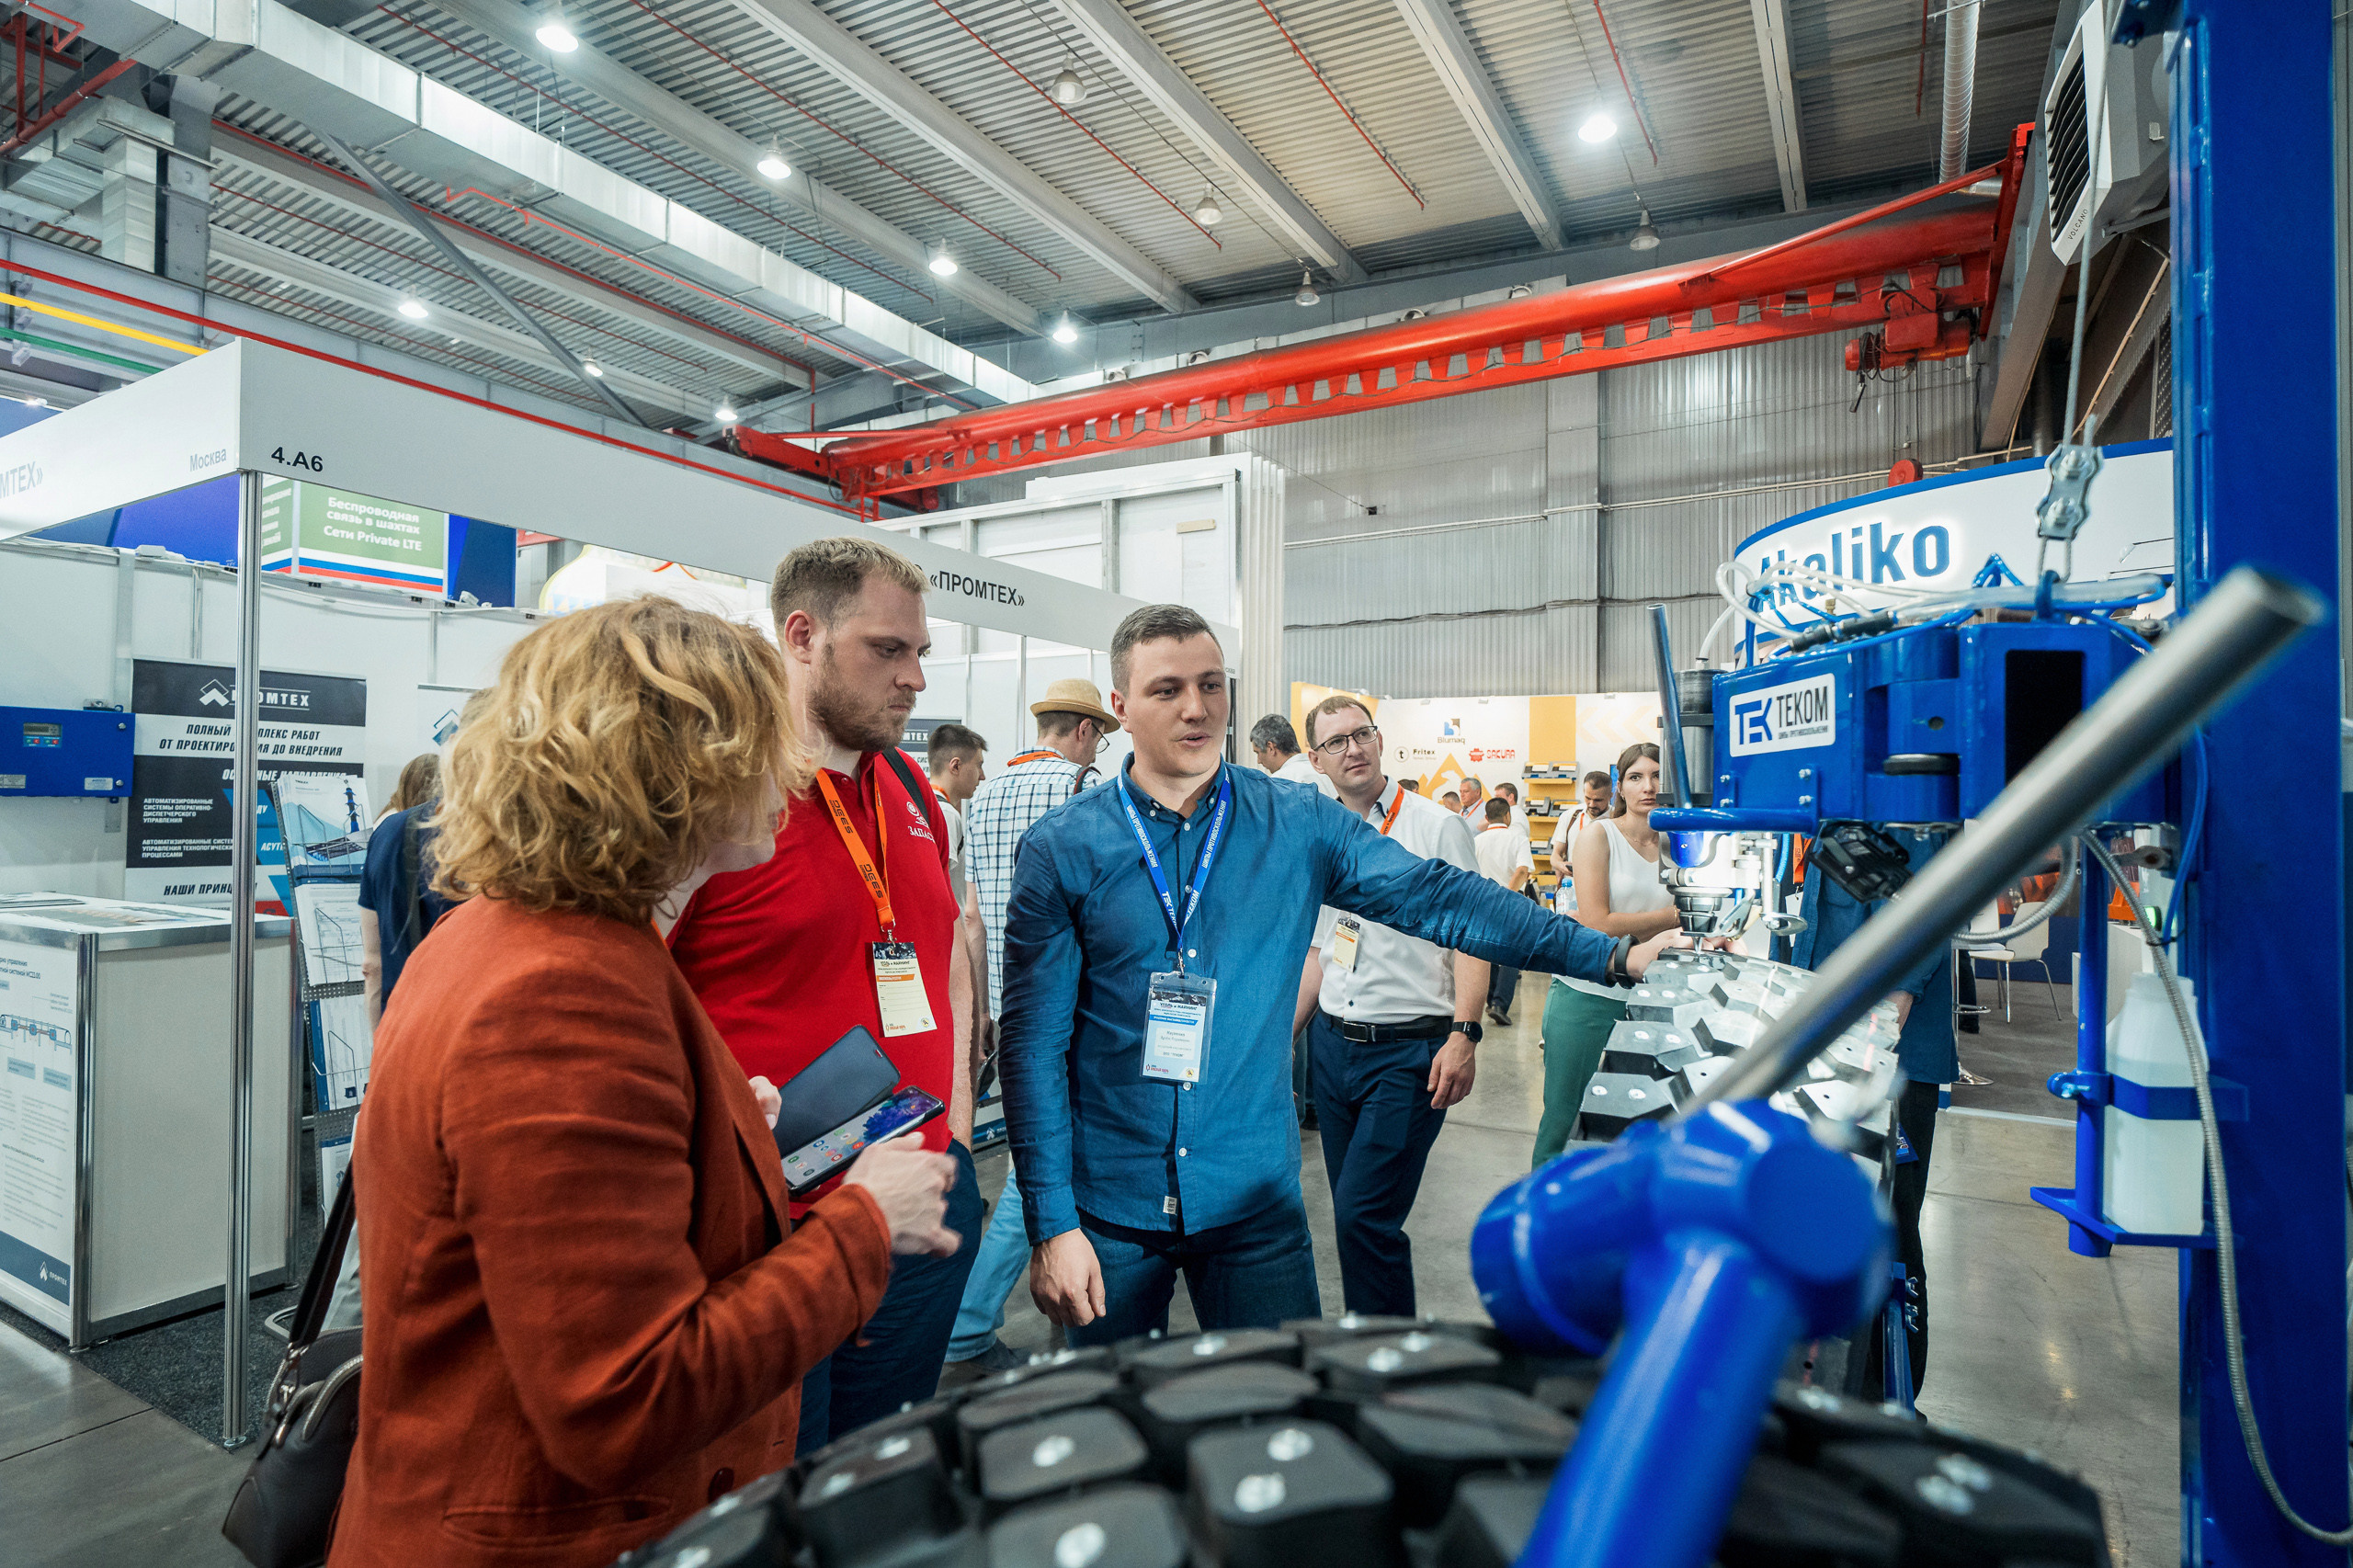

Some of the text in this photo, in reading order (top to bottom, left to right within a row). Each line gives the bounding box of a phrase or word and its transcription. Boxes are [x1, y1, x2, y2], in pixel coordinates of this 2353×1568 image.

[2068, 209, 2087, 240] VOLCANO
[189, 449, 227, 472] Москва
[328, 497, 420, 523] Беспроводная
[326, 510, 420, 534] связь в шахтах
[324, 525, 423, 551] Сети Private LTE
[930, 570, 1025, 607] «ПРОМТЕХ»
[1776, 686, 1828, 728] ТЕКОМ
[187, 723, 232, 736] ПОЛНЫЙ
[290, 730, 321, 741] РАБОТ
[1438, 736, 1465, 745] Blumaq
[159, 739, 343, 756] ОТ ПРОЕКТИРОИЯ ДО ВНЕДРЕНИЯ
[1486, 749, 1516, 759] SAKURA
[164, 884, 196, 896] НАШИ
